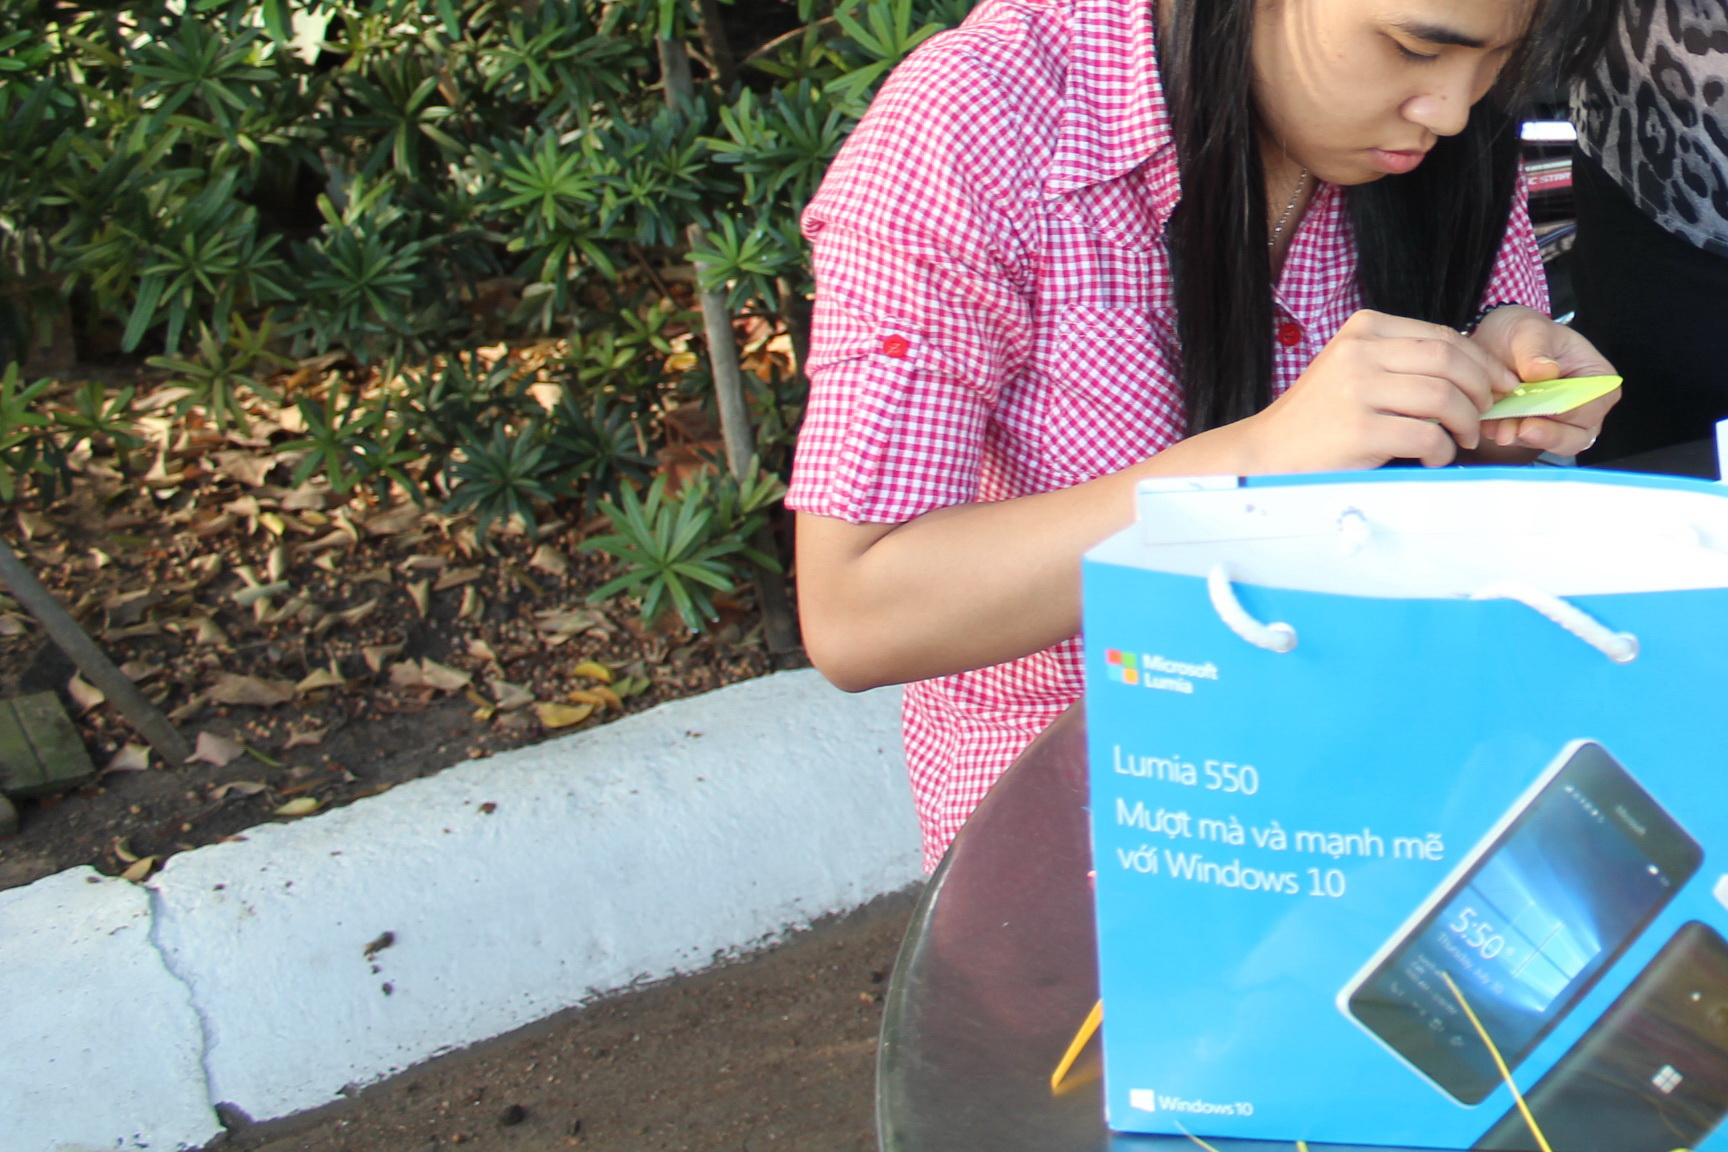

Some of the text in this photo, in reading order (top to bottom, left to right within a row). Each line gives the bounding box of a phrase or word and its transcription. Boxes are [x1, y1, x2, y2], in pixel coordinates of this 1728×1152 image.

[1142, 654, 1219, 680] Microsoft
[1144, 672, 1194, 694] Lumia
[1113, 744, 1259, 795] Lumia 550
[1115, 797, 1444, 861] Mượt mà và mạnh mẽ
[1117, 844, 1346, 898] với Windows 10
[1450, 907, 1505, 960] 5:50
